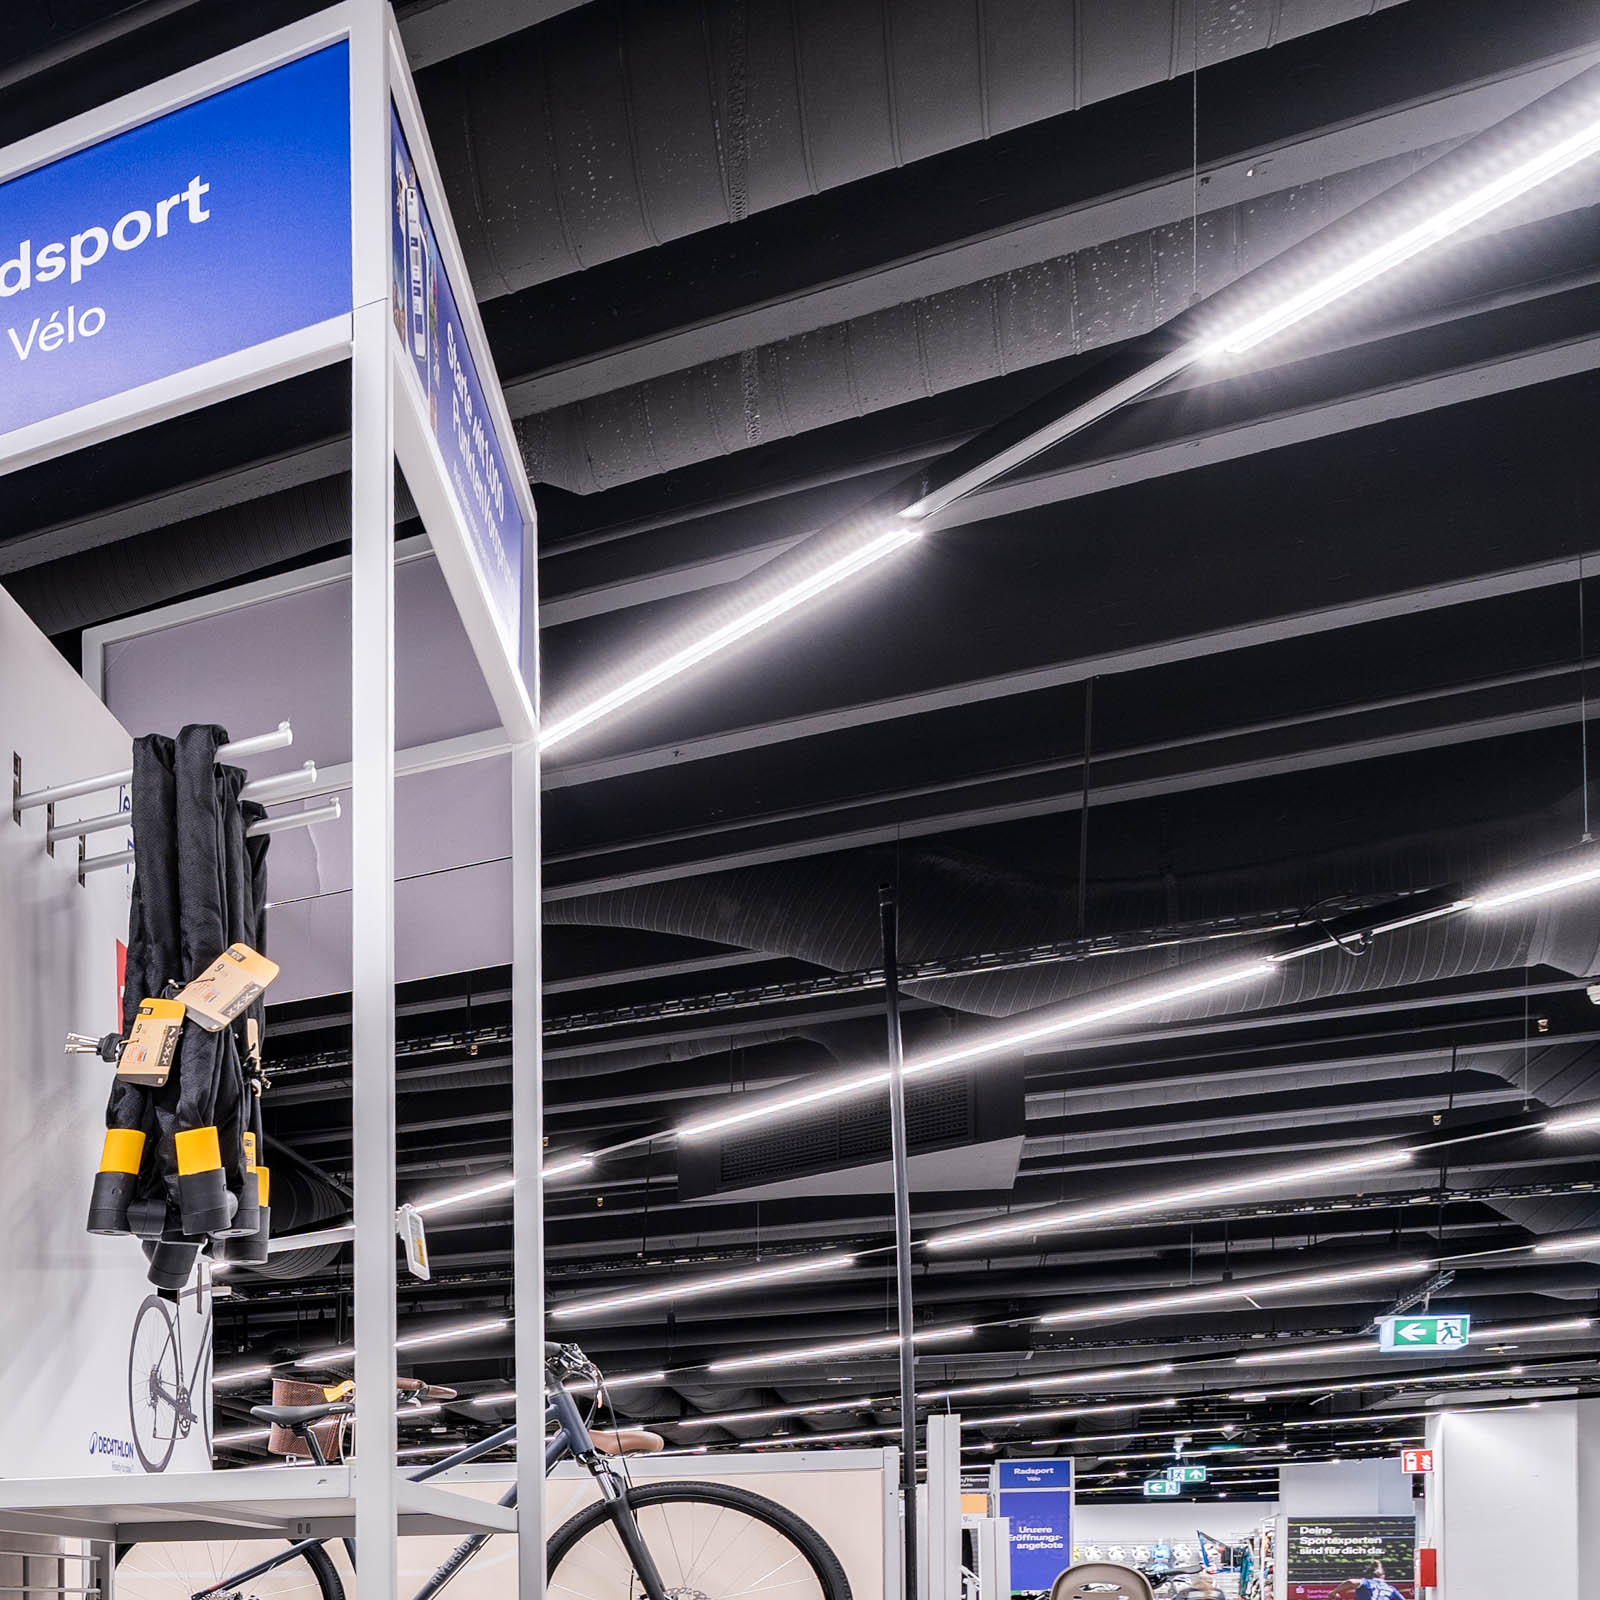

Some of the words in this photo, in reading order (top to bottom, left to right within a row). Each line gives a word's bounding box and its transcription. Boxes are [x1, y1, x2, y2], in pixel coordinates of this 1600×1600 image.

[8, 308, 106, 361] Vélo
[447, 322, 472, 424] Starte
[452, 389, 483, 505] Punkten
[99, 1436, 134, 1459] DECATHLON
[1016, 1542, 1064, 1550] angebote
[1300, 1537, 1382, 1545] Sportexperten
[1300, 1547, 1323, 1555] sind
[1325, 1547, 1340, 1555] für
[1341, 1547, 1366, 1555] dich
[431, 1535, 475, 1586] RIVERSIDE
